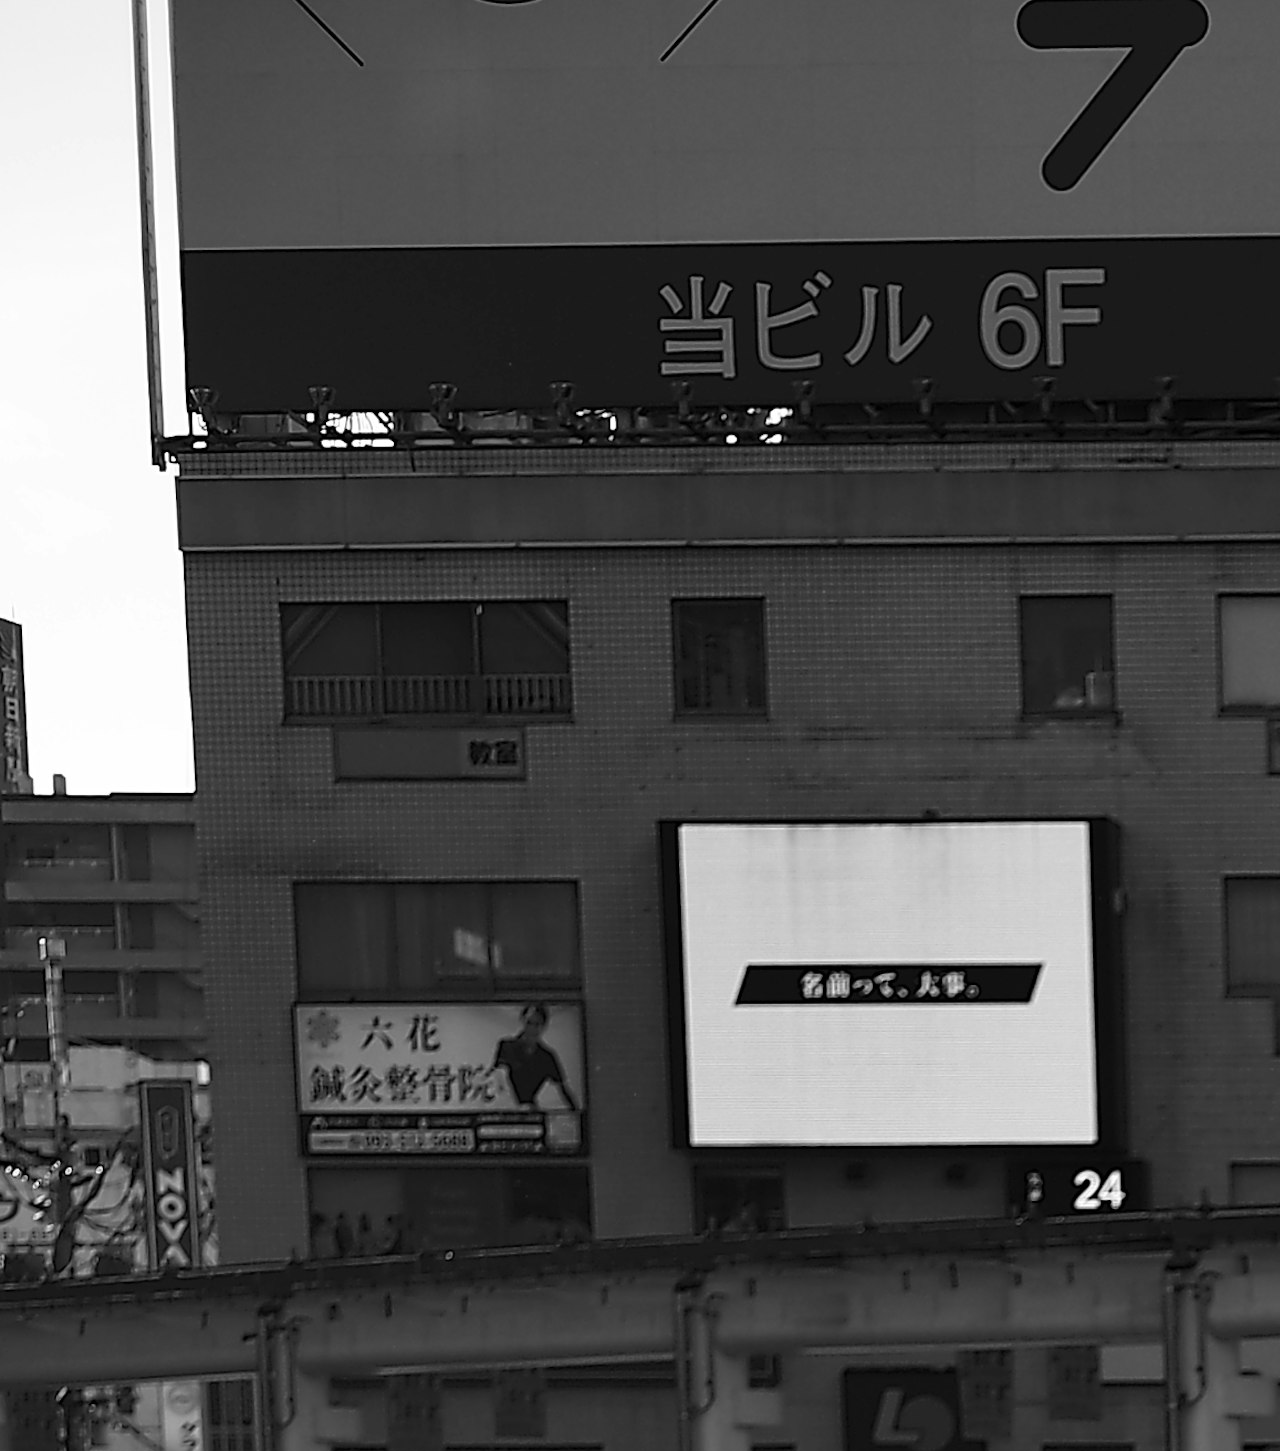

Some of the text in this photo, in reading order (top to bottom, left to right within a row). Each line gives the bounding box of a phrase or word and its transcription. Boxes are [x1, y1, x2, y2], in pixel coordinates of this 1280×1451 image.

[656, 267, 1108, 380] 当ビル 6F
[360, 1014, 441, 1051] 六花
[1071, 1167, 1127, 1211] 24
